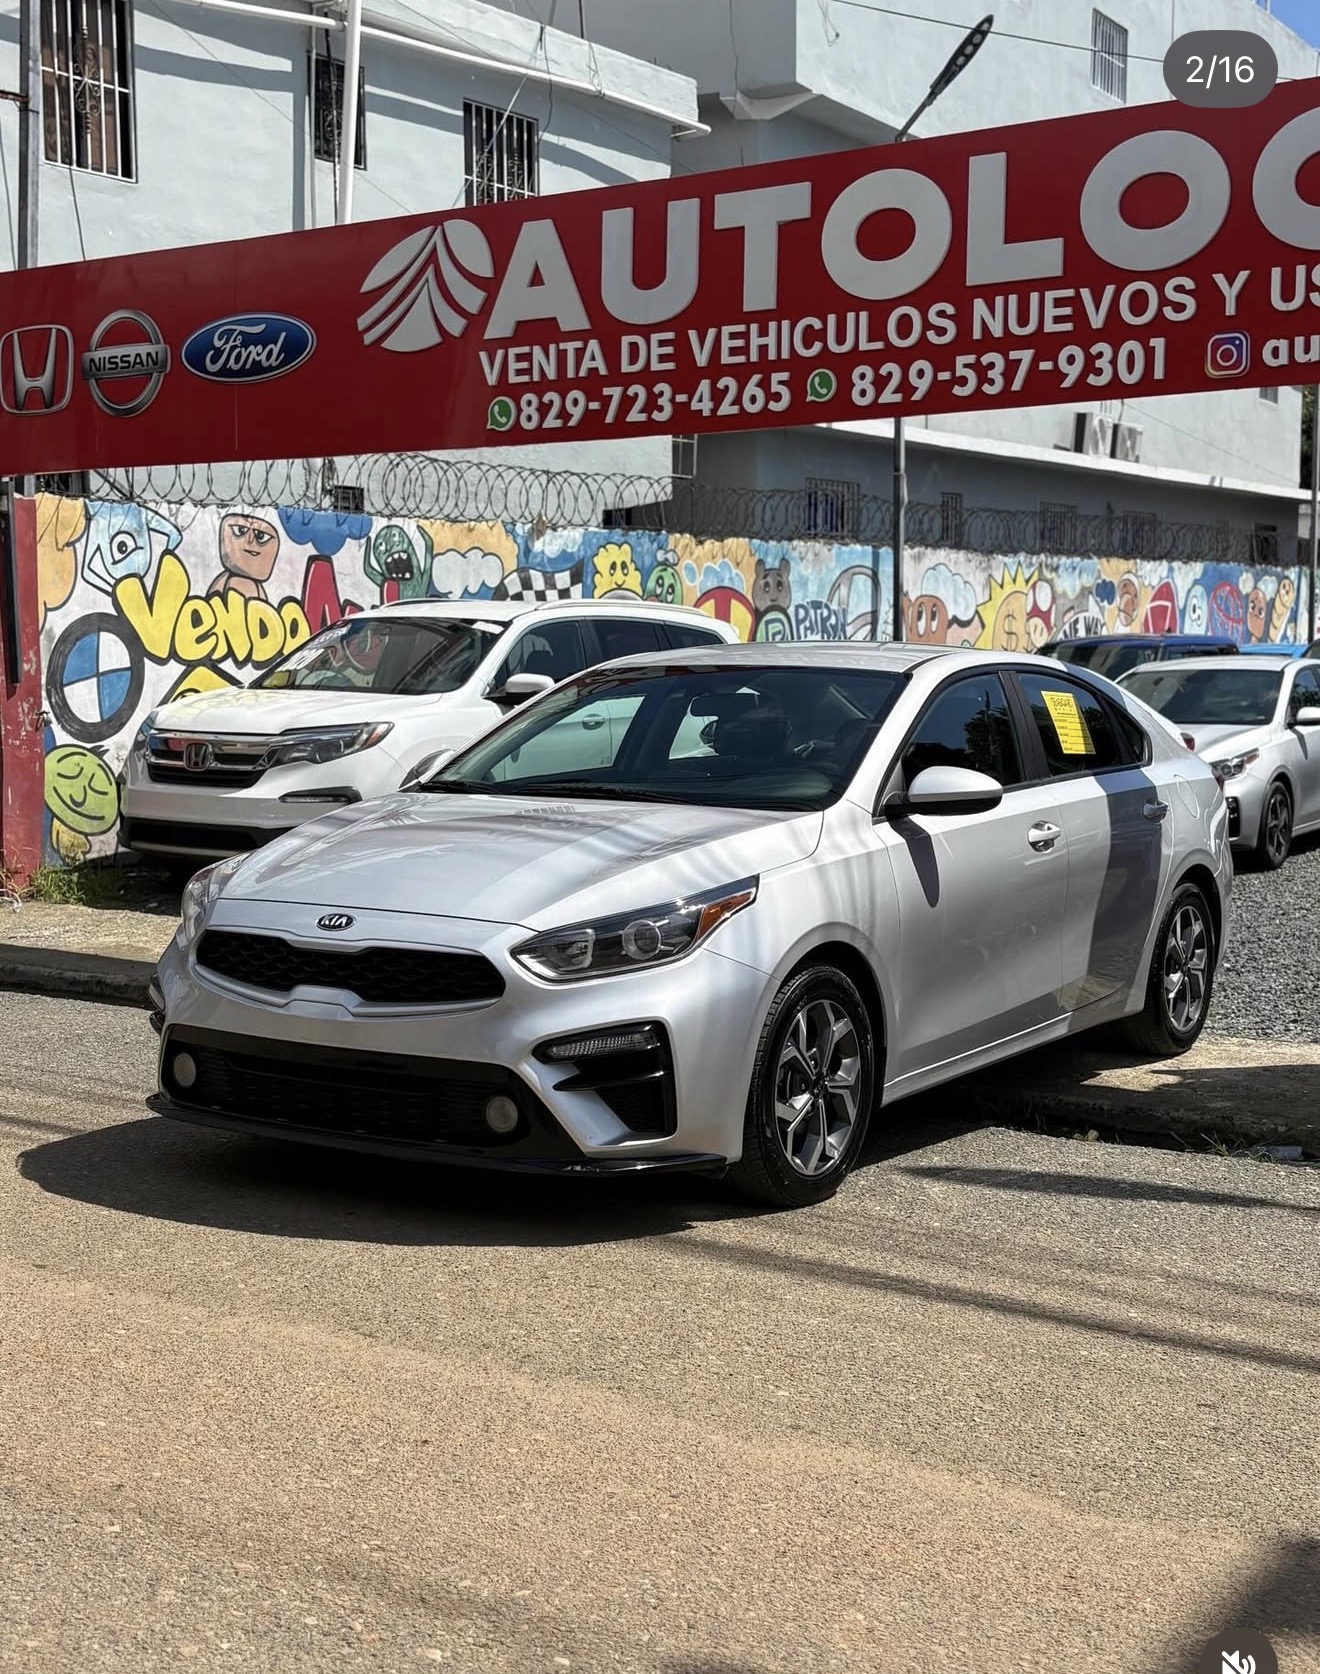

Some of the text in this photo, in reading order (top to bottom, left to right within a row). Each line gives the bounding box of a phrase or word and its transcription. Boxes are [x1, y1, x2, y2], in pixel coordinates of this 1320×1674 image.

[205, 323, 287, 373] Ford
[479, 338, 609, 386] VENTA
[620, 331, 677, 374] DE
[687, 301, 958, 368] VEHICULOS
[972, 276, 1198, 340] NUEVOS
[1211, 269, 1252, 317] Y
[88, 350, 159, 374] NISSAN
[518, 371, 792, 431] 829-723-4265
[851, 337, 1167, 407] 829-537-9301
[320, 914, 348, 927] KIA
